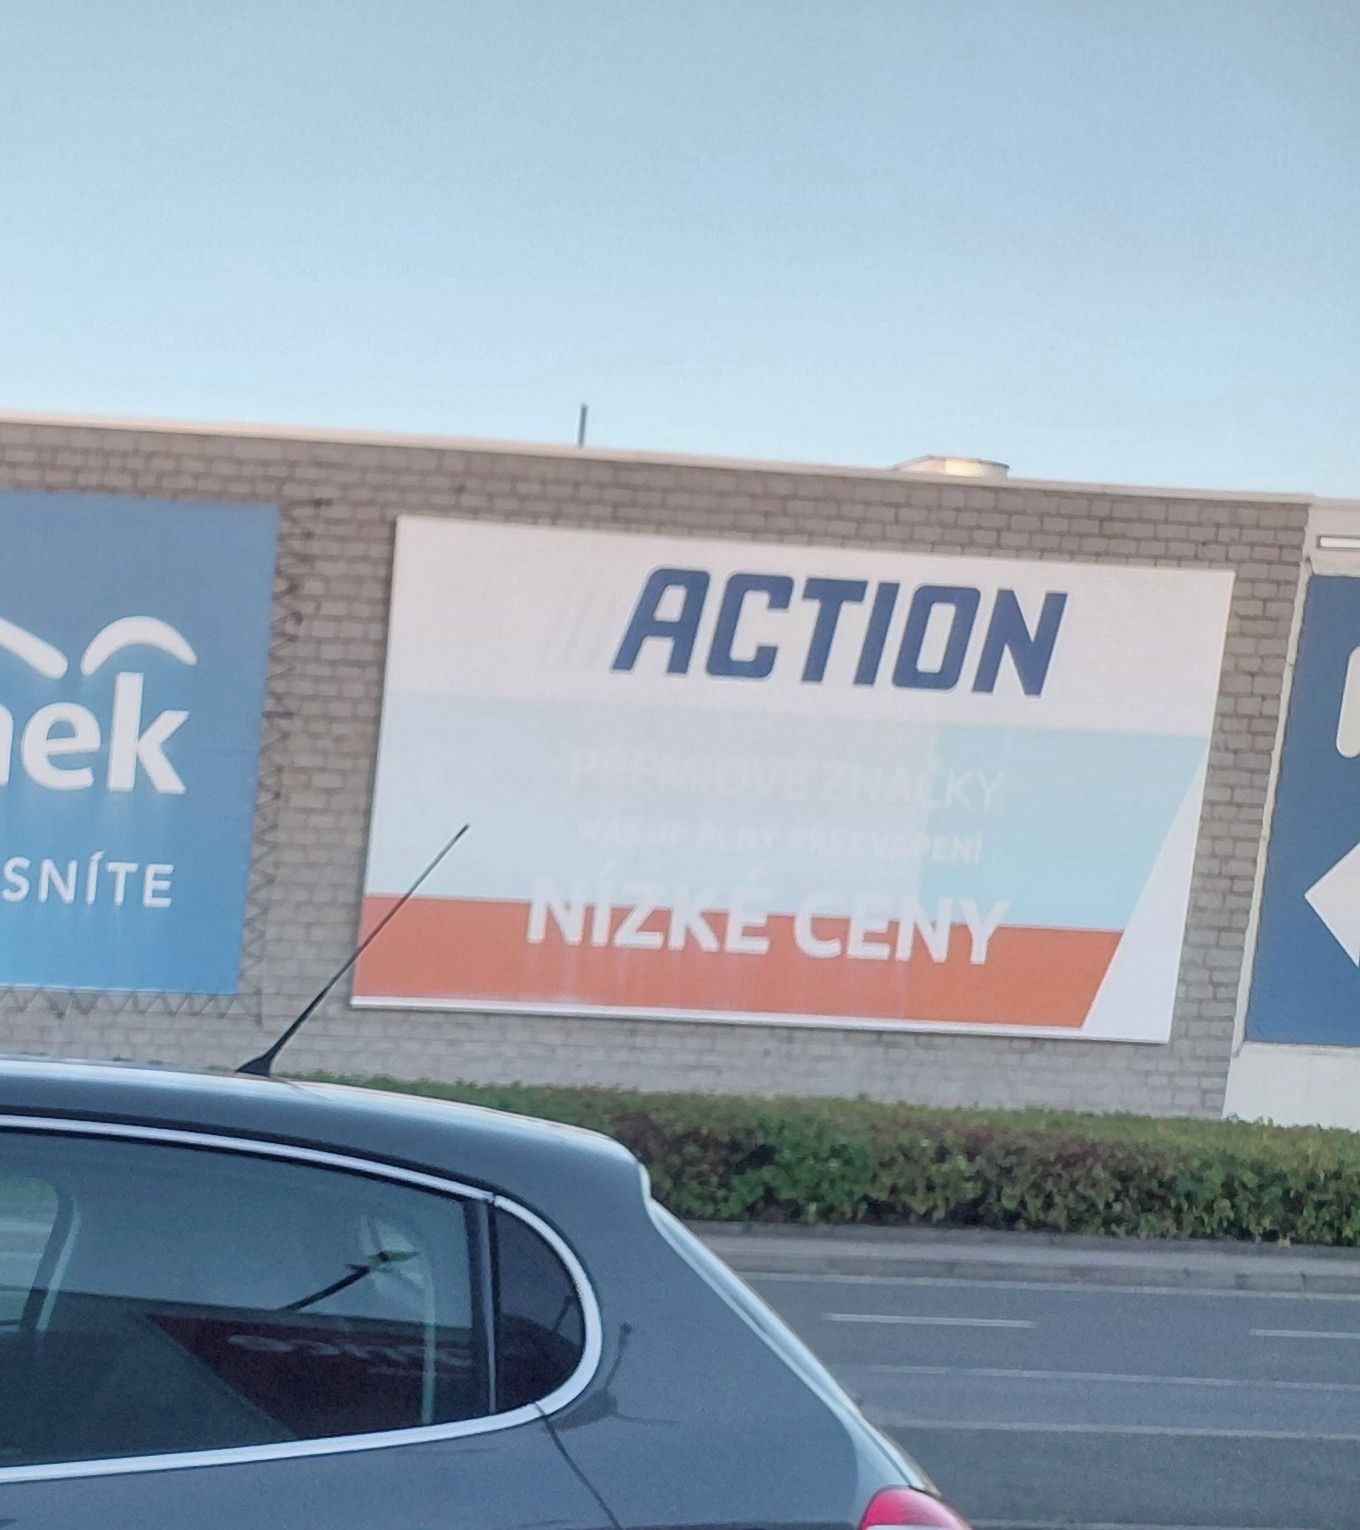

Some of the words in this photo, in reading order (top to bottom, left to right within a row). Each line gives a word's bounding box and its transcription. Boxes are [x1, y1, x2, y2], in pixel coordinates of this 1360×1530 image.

[611, 567, 1068, 697] ACTION
[1, 850, 175, 908] SNÍTE
[526, 859, 772, 956] NÍZKÉ
[793, 893, 1012, 966] CENY
